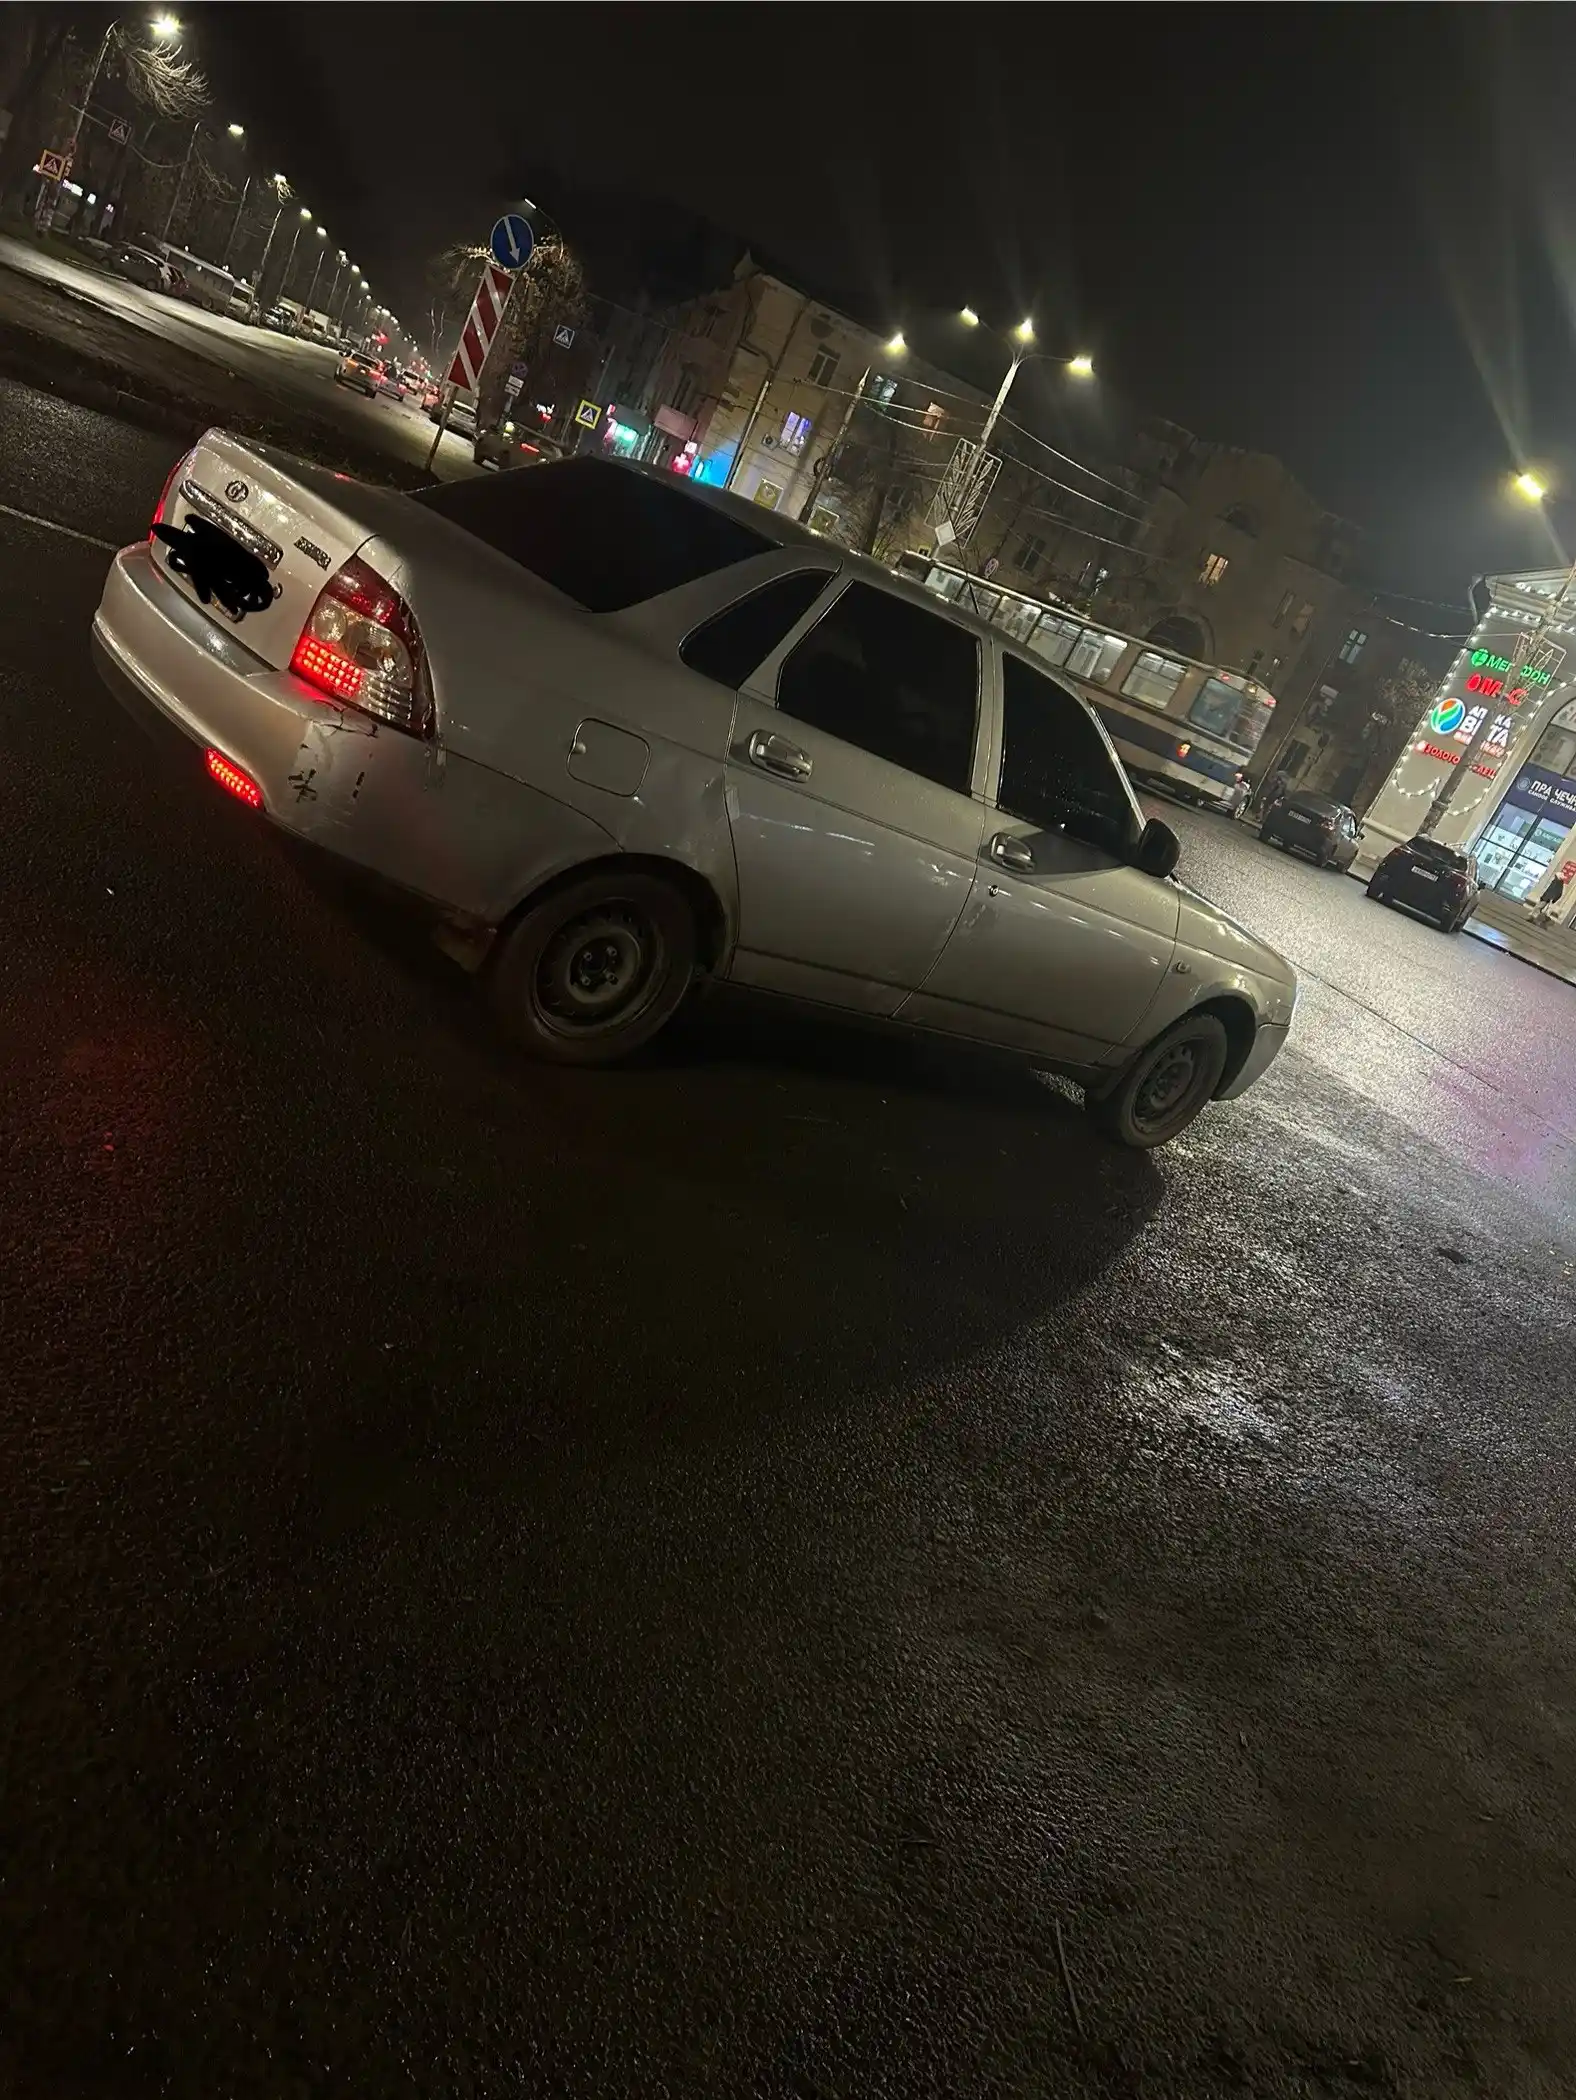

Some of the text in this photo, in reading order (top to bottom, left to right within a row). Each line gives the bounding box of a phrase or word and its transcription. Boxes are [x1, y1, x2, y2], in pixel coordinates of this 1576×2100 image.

[1486, 655, 1551, 685] МЕГФОН
[1468, 705, 1512, 729] АПКА
[1459, 715, 1510, 748] ВТА
[1423, 742, 1461, 766] ЗОЛОТО
